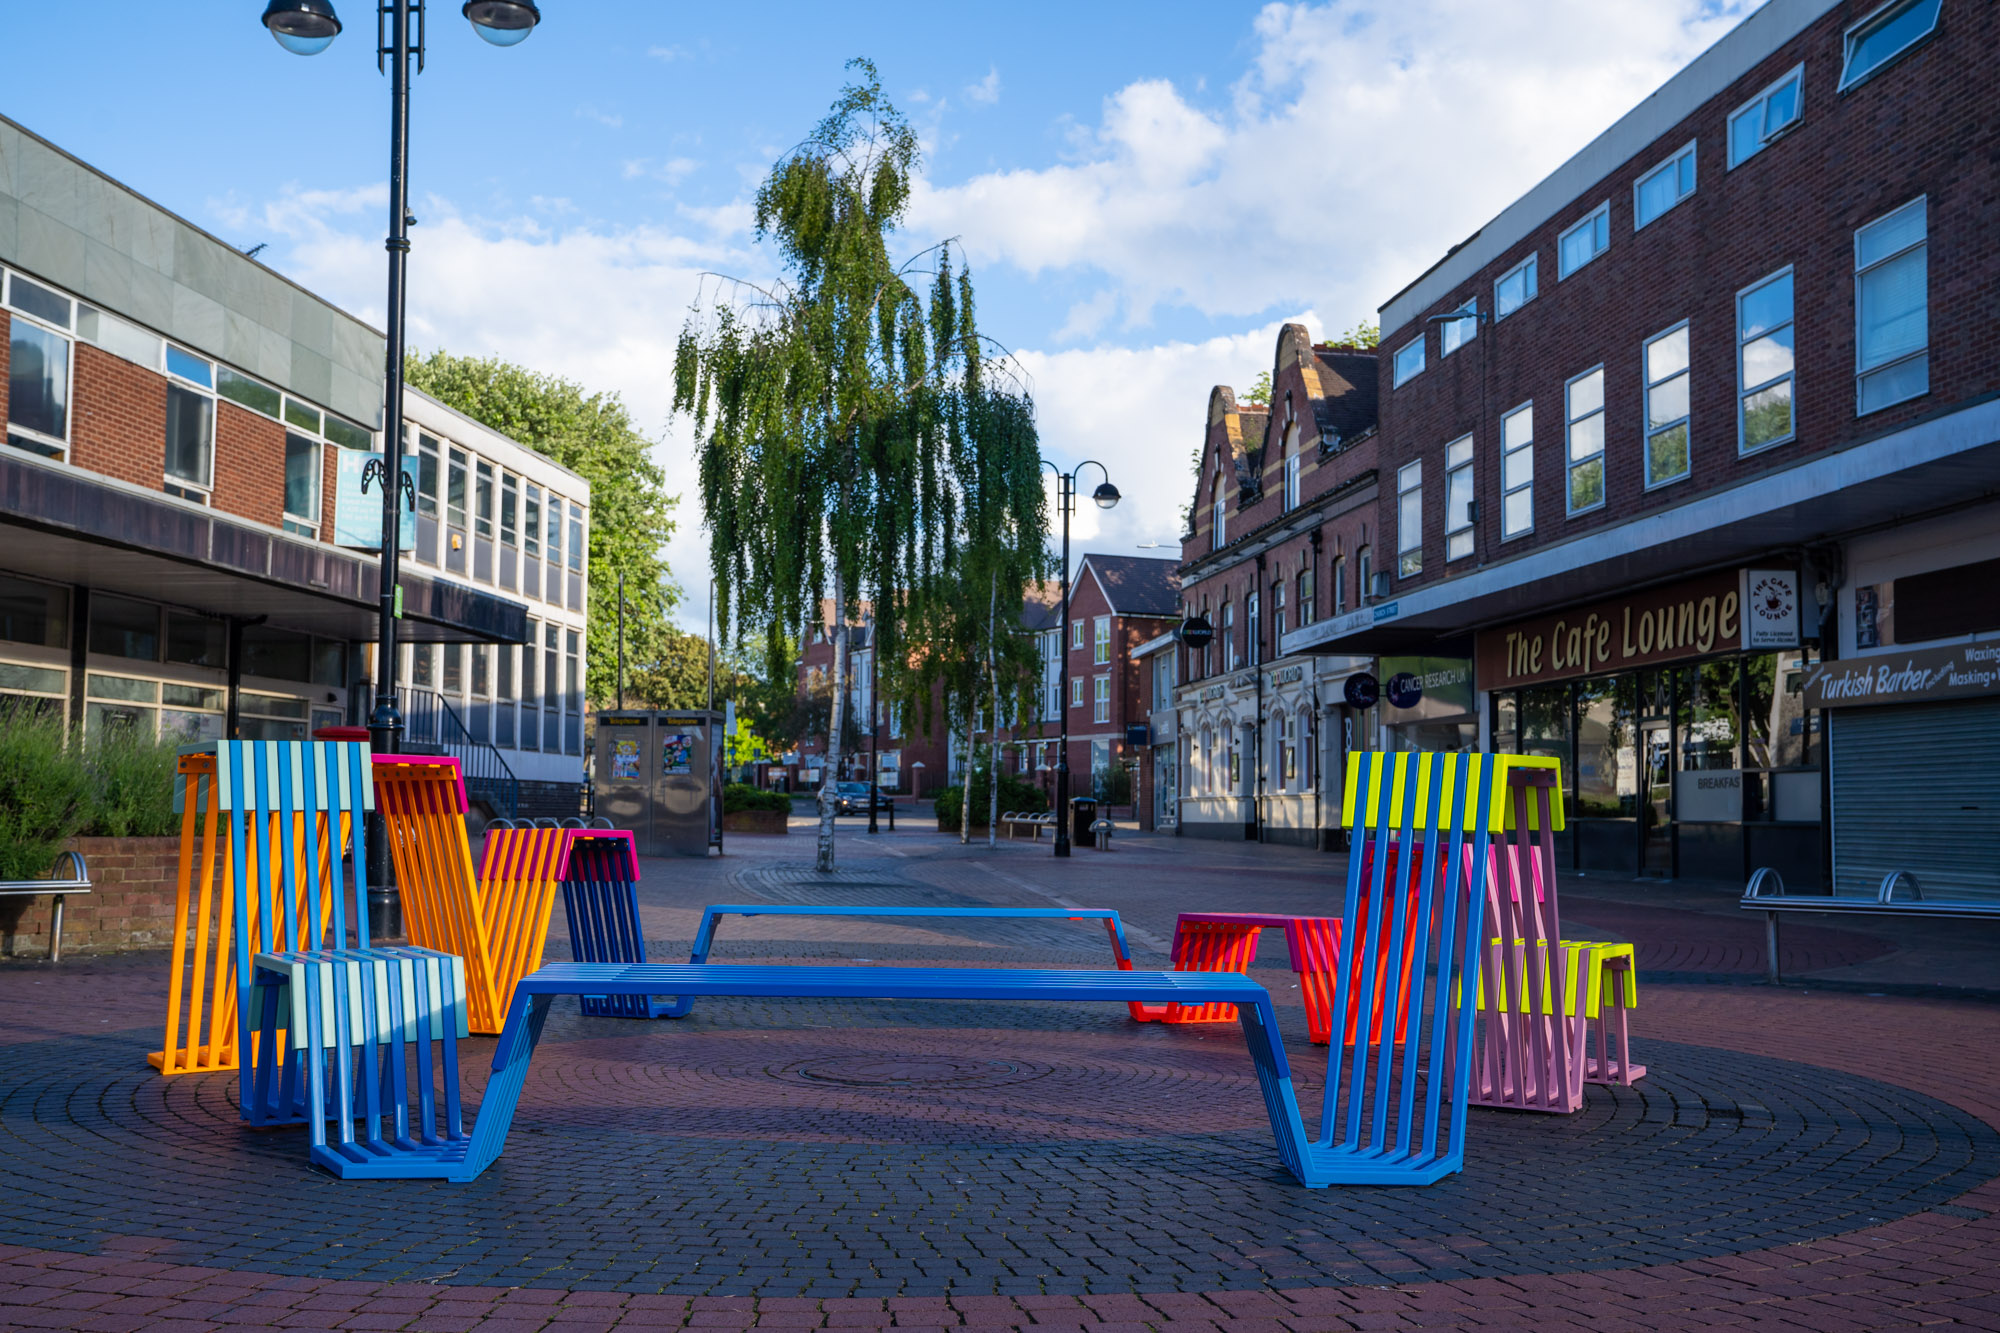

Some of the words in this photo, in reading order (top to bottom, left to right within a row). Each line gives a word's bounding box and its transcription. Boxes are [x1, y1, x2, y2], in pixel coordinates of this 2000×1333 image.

[1752, 578, 1769, 598] THE
[1770, 577, 1793, 597] CAFE
[1754, 603, 1793, 621] LOUNGE
[1506, 631, 1543, 678] The
[1552, 613, 1611, 674] Cafe
[1622, 590, 1738, 658] Lounge
[1965, 645, 2000, 663] Waxing
[1400, 676, 1424, 694] CANCER
[1425, 669, 1456, 690] RESEARCH
[1456, 667, 1466, 683] UK
[1821, 665, 1873, 700] Turkish
[1876, 660, 1932, 694] Barber
[1948, 668, 1990, 688] Masking
[1697, 776, 1741, 790] BREAKFAS
